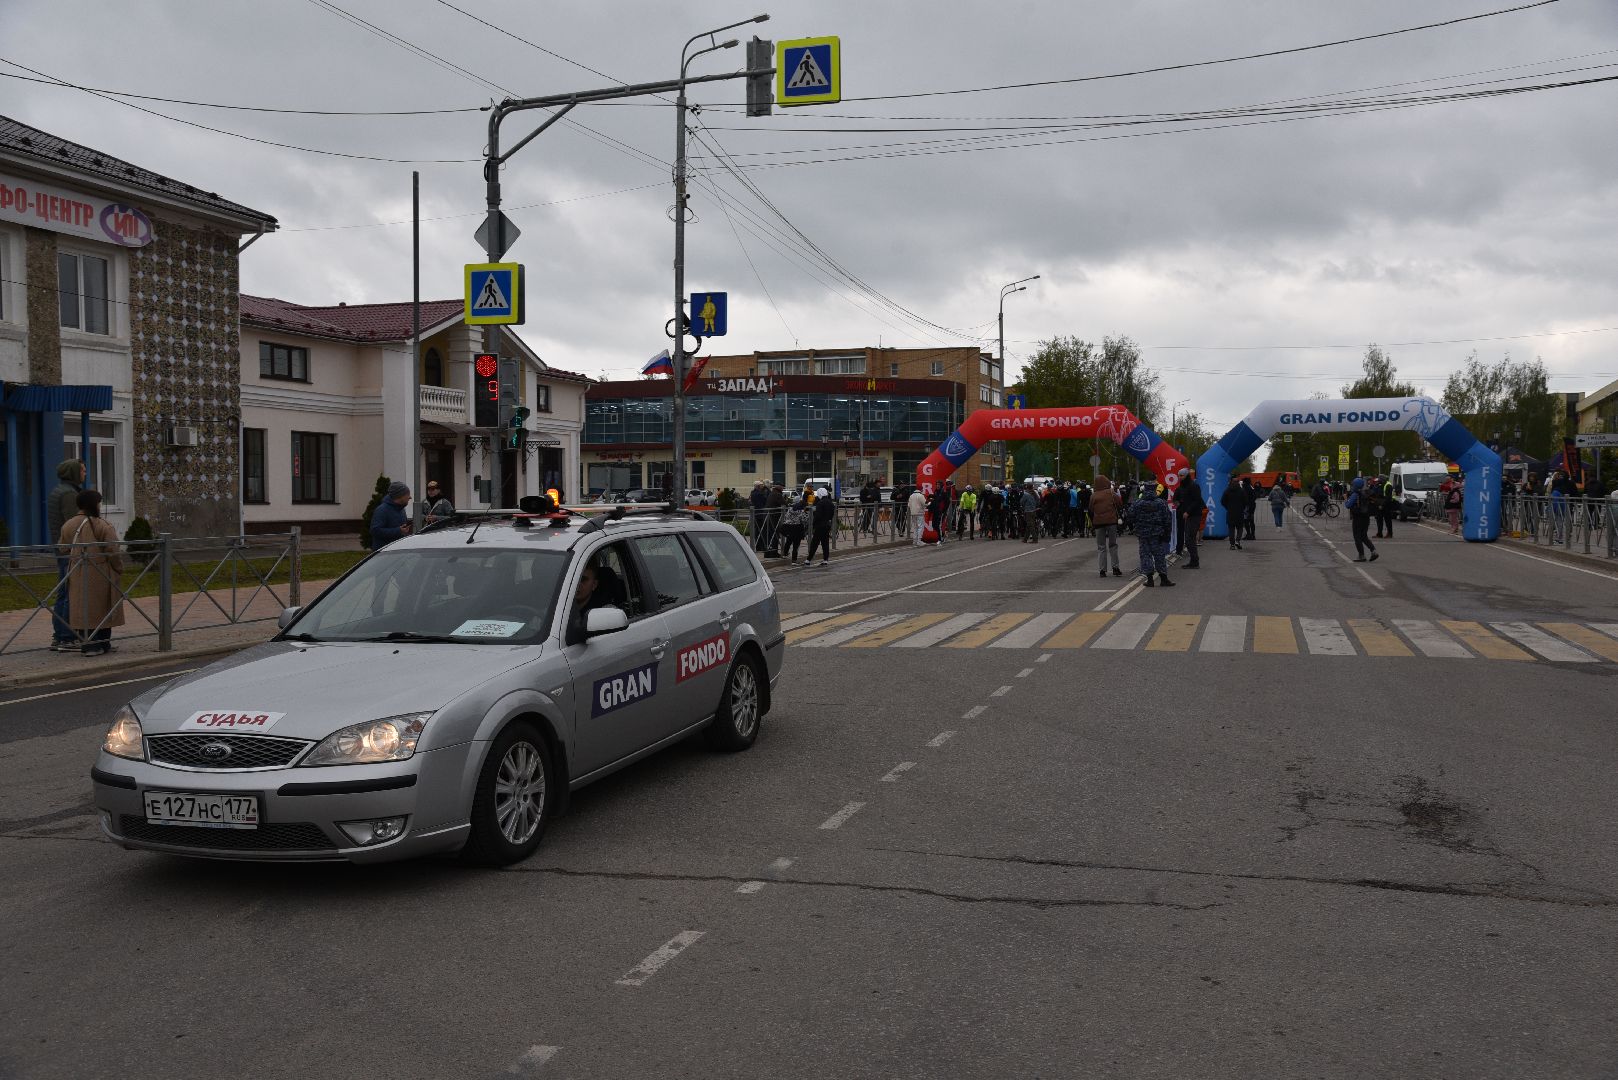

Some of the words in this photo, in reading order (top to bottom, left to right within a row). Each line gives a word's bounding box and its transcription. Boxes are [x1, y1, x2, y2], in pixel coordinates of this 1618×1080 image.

[489, 381, 498, 400] 9
[718, 378, 768, 393] ЗАПАД
[991, 417, 1034, 429] GRAN
[1039, 415, 1092, 428] FONDO
[1280, 413, 1332, 424] GRAN
[1337, 410, 1400, 423] FONDO
[922, 464, 934, 532] GRN
[1205, 468, 1216, 536] START
[1477, 466, 1490, 539] FINISH
[599, 667, 652, 710] GRAN
[680, 638, 726, 678] FONDO
[225, 798, 252, 815] 177
